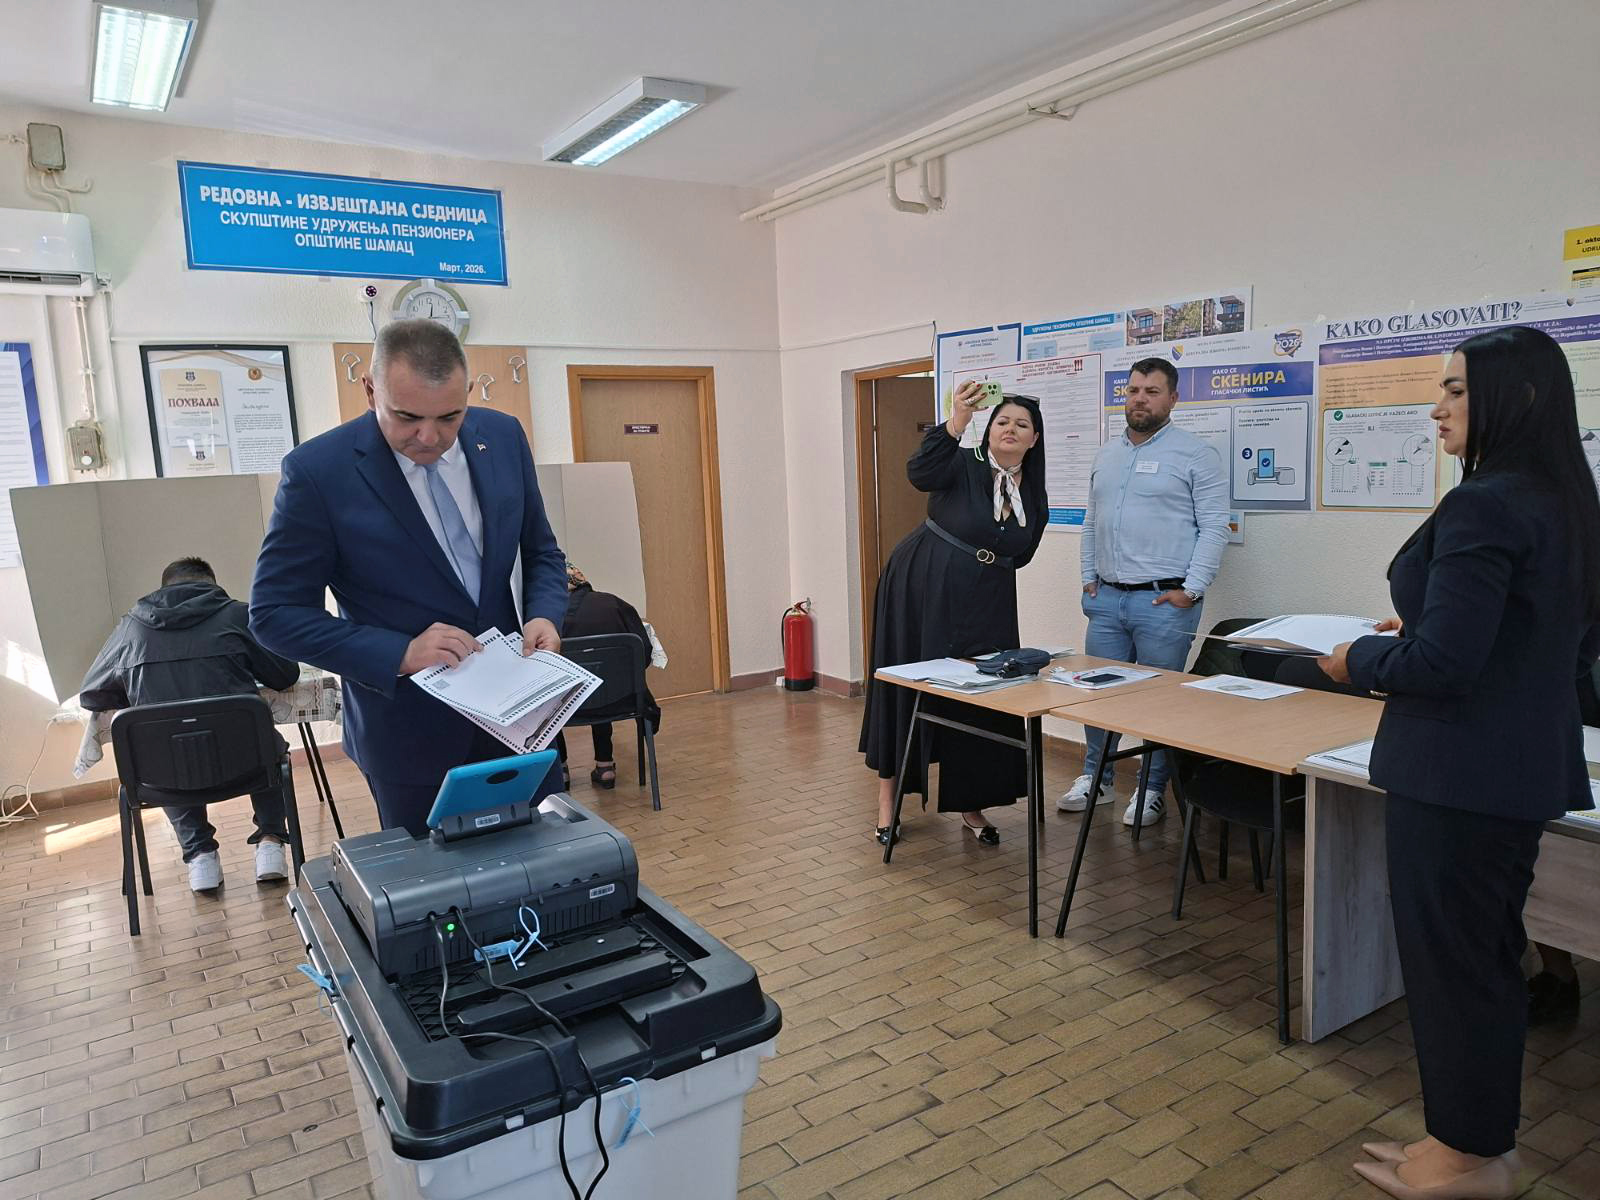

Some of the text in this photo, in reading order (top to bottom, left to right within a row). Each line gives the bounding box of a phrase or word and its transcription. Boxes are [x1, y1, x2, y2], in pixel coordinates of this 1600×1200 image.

[200, 185, 282, 208] РЕДОВНА
[297, 193, 409, 217] ИЗВЈЕШТАЈНА
[411, 203, 488, 226] СЈЕДНИЦА
[220, 210, 475, 242] СКУПШТИНЕ УДРУЖЕЊА ПЕНЗИОНЕРА
[295, 233, 415, 257] ОПШТИНЕ ШАМАЦ
[465, 263, 487, 274] 2026.
[1326, 318, 1384, 341] KAKO
[1387, 301, 1523, 334] GLASOVATI?
[1275, 339, 1301, 349] 2026
[1211, 370, 1286, 389] СКЕНИРА
[1211, 385, 1269, 396] ГЛАСАЧКИ ЛИСТИЋ
[168, 398, 220, 408] ПОХВАЛА
[1244, 449, 1250, 458] 3
